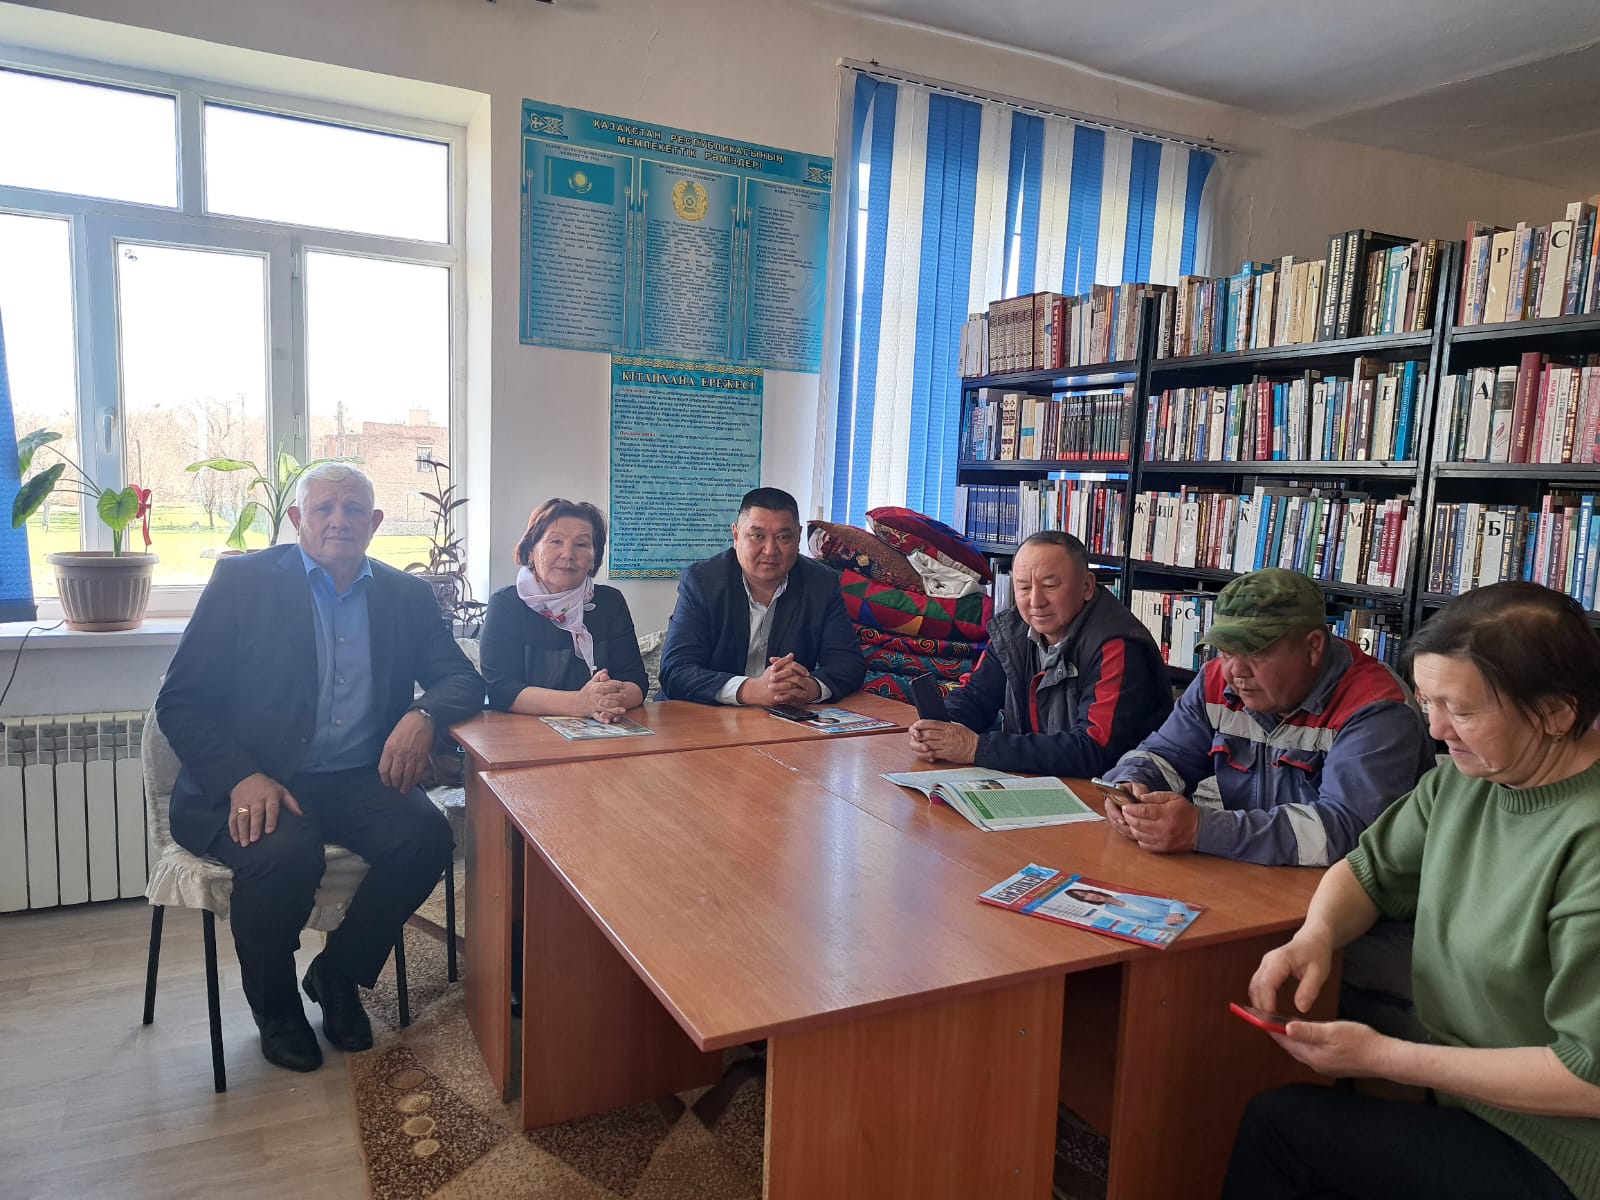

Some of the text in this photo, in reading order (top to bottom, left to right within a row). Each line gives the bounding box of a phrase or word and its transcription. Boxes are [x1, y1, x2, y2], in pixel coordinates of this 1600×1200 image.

[593, 119, 784, 165] ҚАЗАҚСТАН РЕСПУБЛИКАСЫНЫҢ
[617, 135, 697, 158] МЕМЛЕКЕТТІК
[704, 151, 763, 170] РӘМІЗДЕРІ
[621, 371, 757, 391] КІТАПХАНА ЕРЕЖЕСІ
